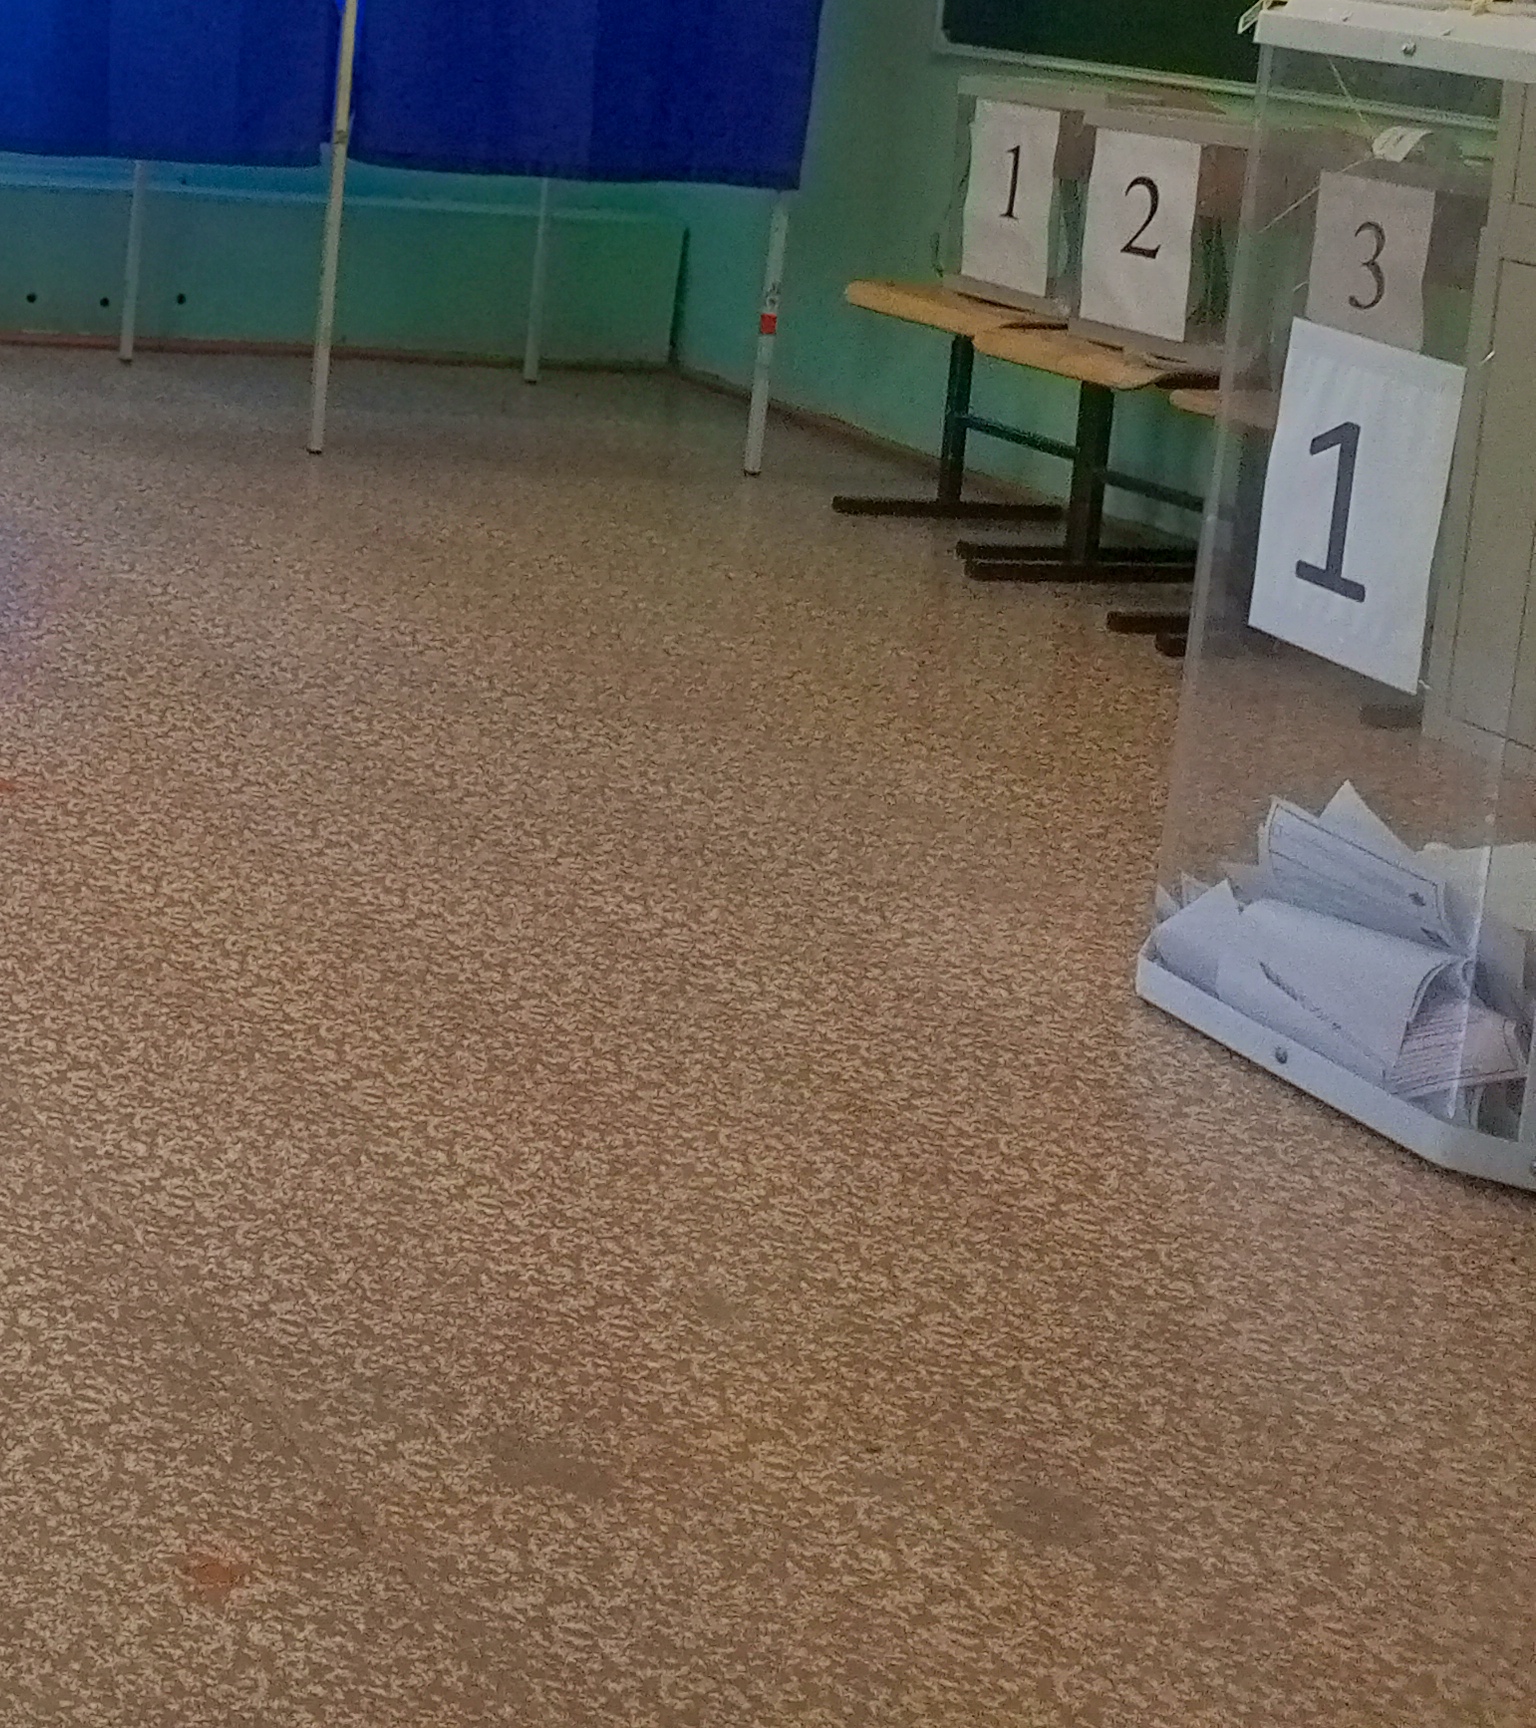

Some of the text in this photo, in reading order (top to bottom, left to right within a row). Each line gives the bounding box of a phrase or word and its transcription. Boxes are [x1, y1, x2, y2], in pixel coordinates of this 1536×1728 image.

[999, 145, 1022, 220] 1
[1120, 176, 1161, 260] 2
[1348, 220, 1386, 310] 3
[1294, 421, 1366, 604] 1
